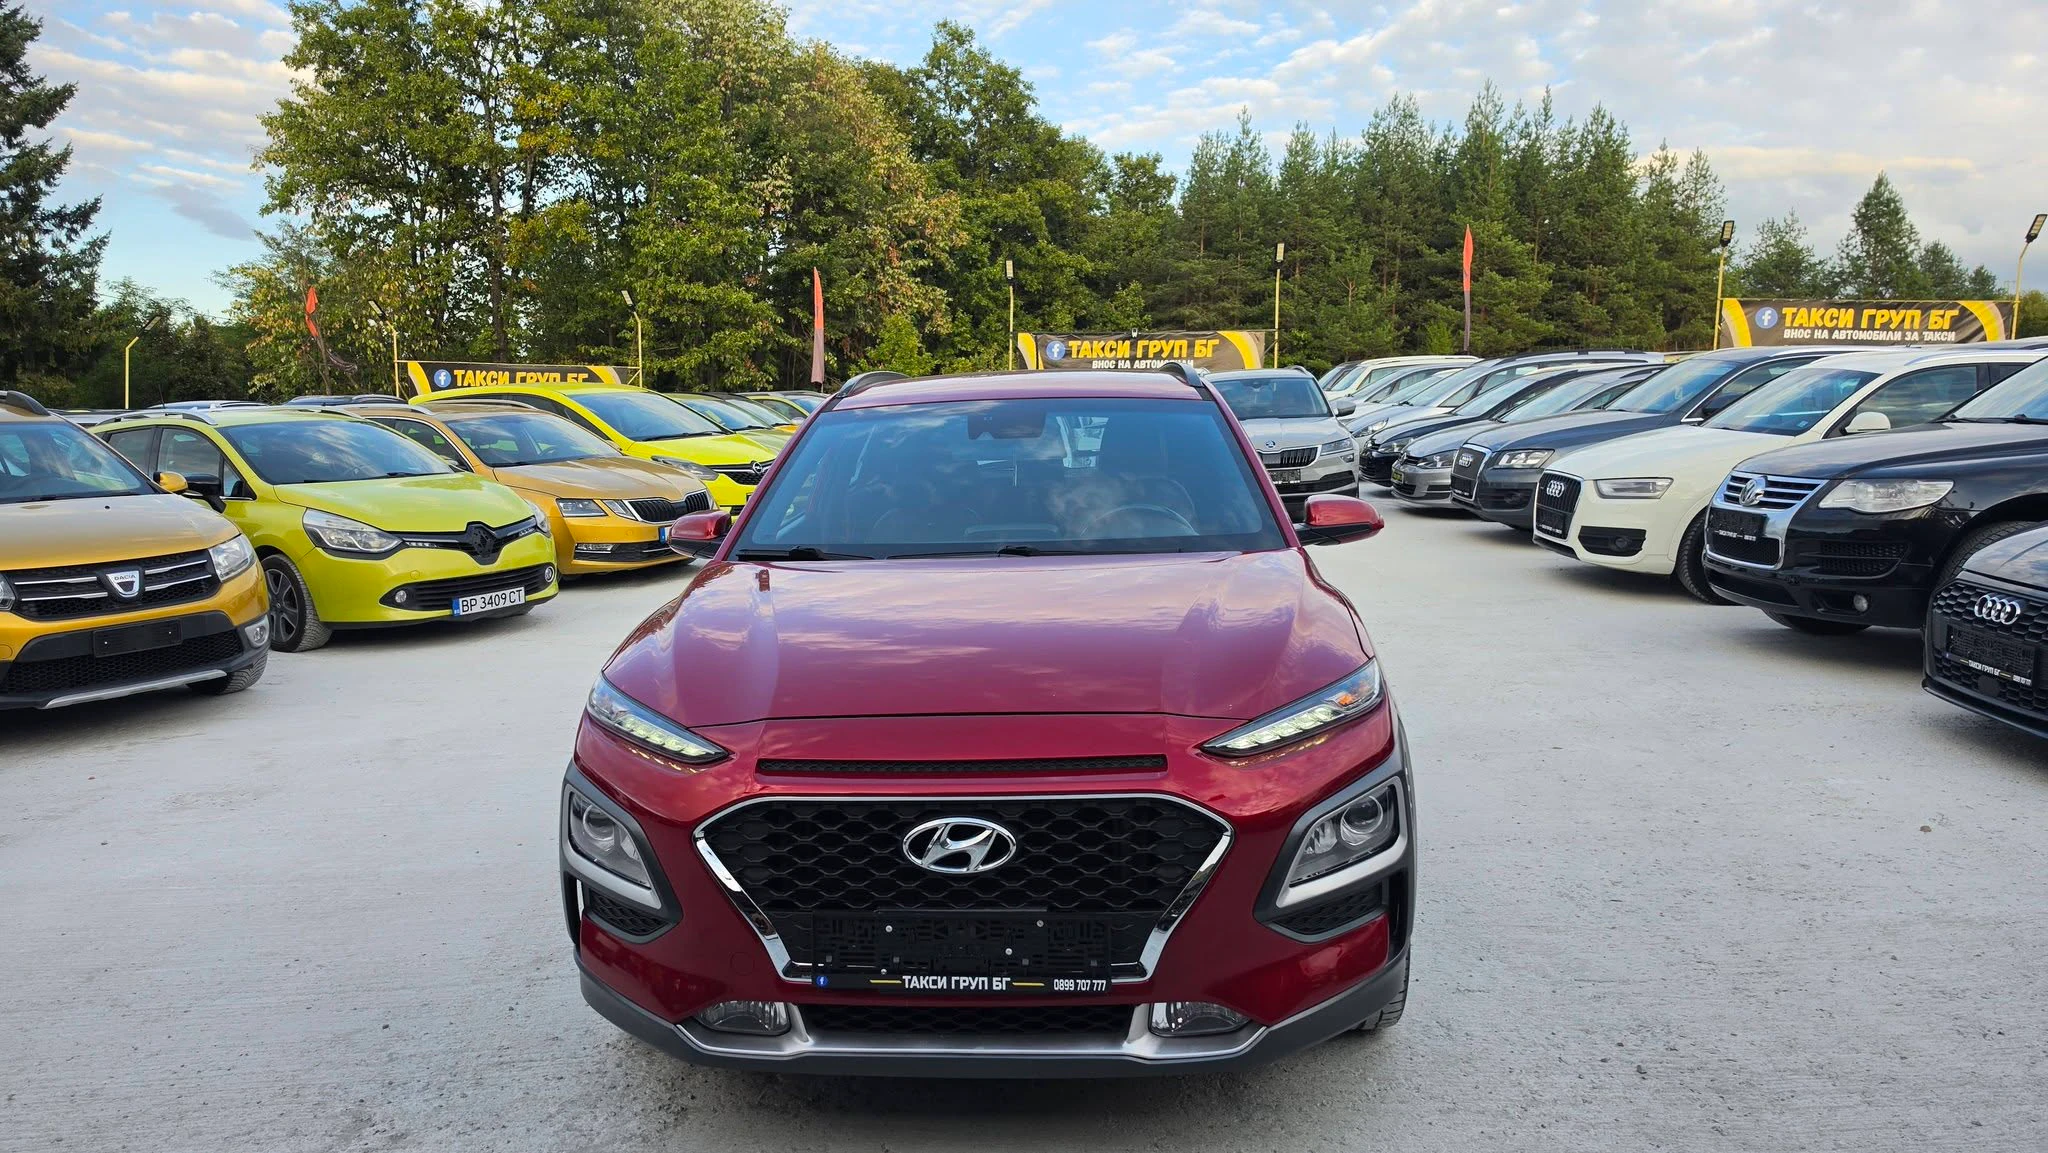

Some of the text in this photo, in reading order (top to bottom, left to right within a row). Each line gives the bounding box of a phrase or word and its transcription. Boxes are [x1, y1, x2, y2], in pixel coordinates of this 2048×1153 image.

[1782, 307, 1960, 330] ТАКСИ ГРУП БГ
[1783, 329, 1956, 342] ВНОС НА АВТОМОБИЛИ ЗА ТАКСИ
[1068, 339, 1220, 359] ТАКСИ ГРУП БГ
[1092, 360, 1116, 369] ВНОС
[1117, 360, 1131, 369] НА
[453, 369, 509, 387] ТАКСИ
[461, 589, 523, 613] BP 3409 CT
[902, 975, 1011, 991] ТАКСИ ГРУП БГ
[1053, 979, 1107, 991] 0899 707 777
